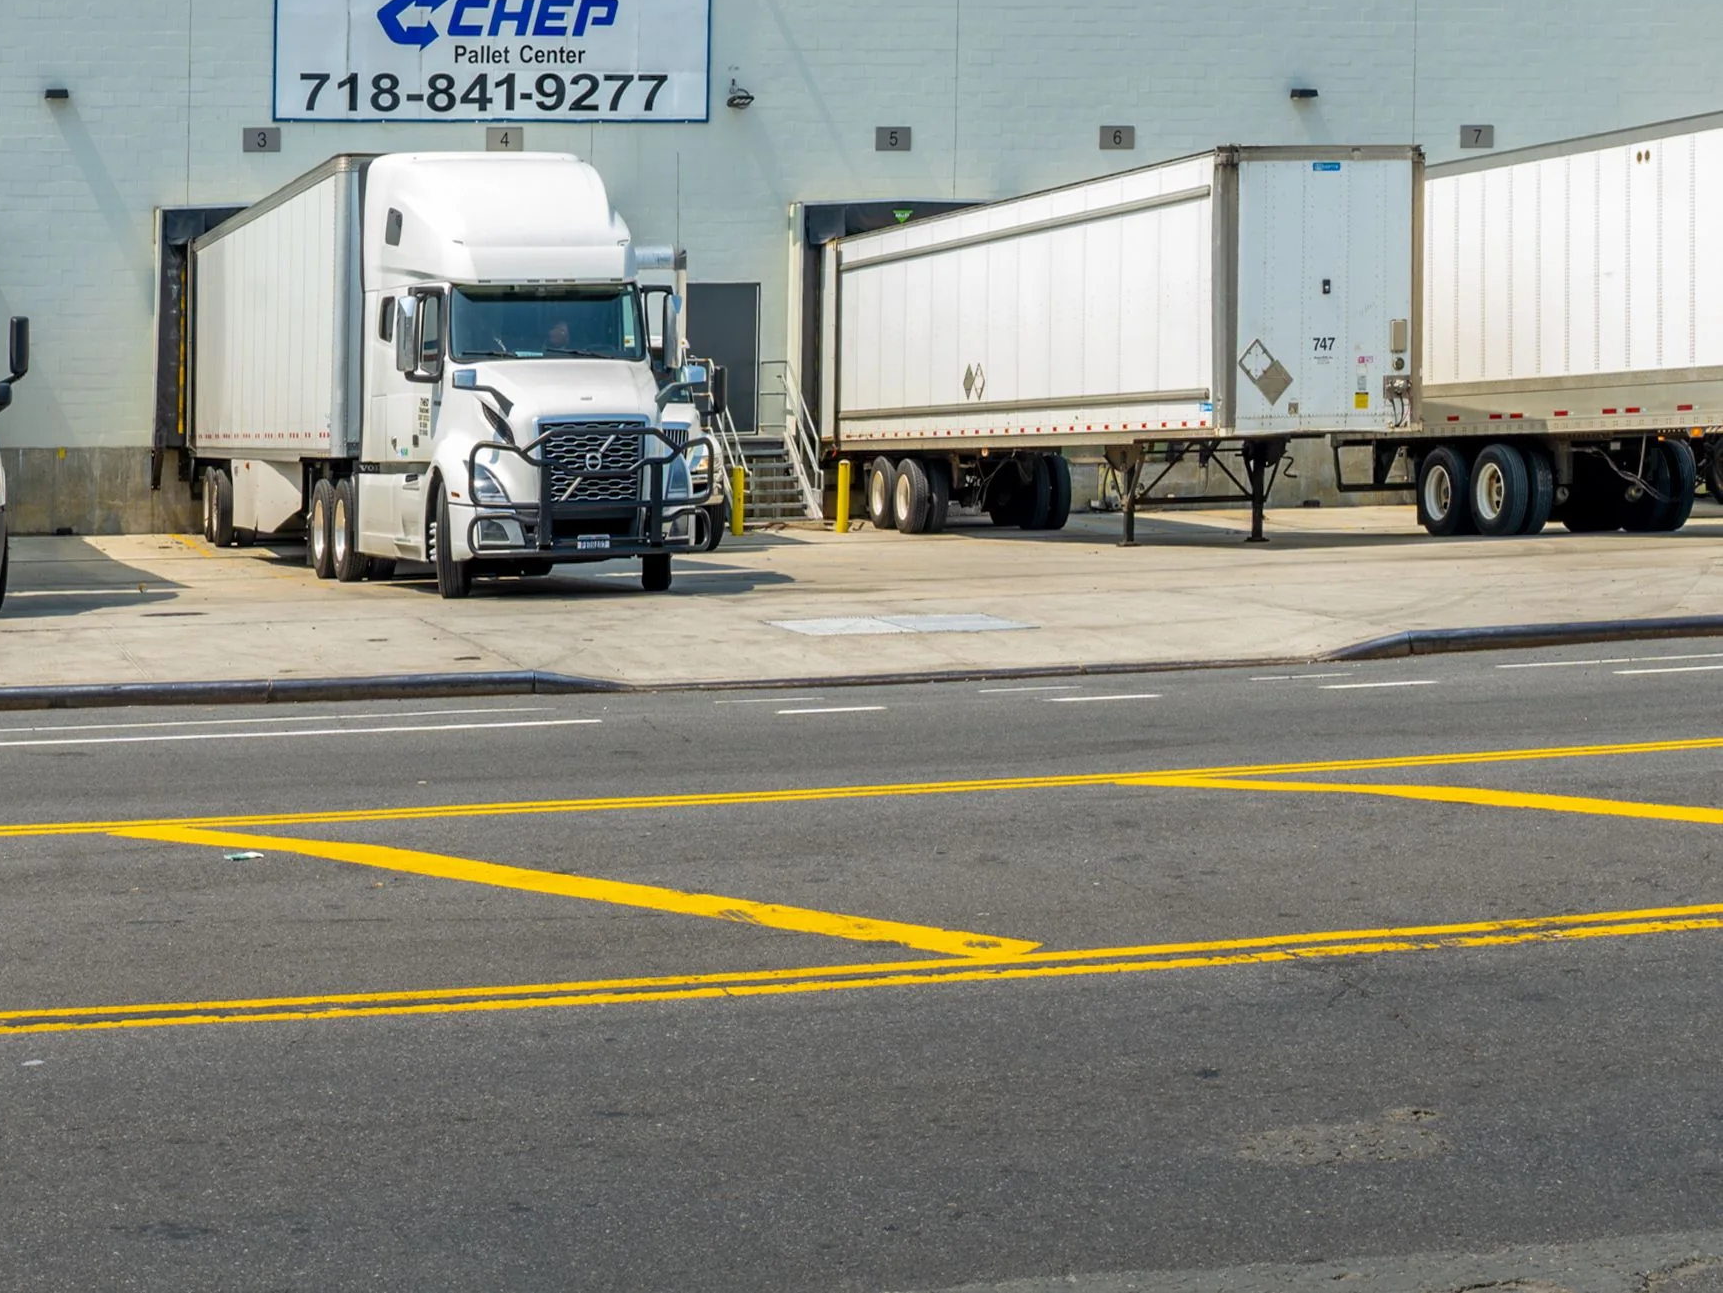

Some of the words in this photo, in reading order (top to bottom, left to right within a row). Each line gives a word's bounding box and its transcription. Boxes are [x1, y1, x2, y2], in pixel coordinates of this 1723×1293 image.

[454, 44, 510, 64] Pallet
[519, 44, 586, 64] Center
[299, 72, 669, 113] 718-841-9277
[257, 131, 267, 148] 3
[500, 132, 510, 148] 4
[888, 130, 899, 147] 5
[1113, 129, 1122, 146] 6
[1473, 128, 1482, 145] 7
[1312, 337, 1335, 351] 747
